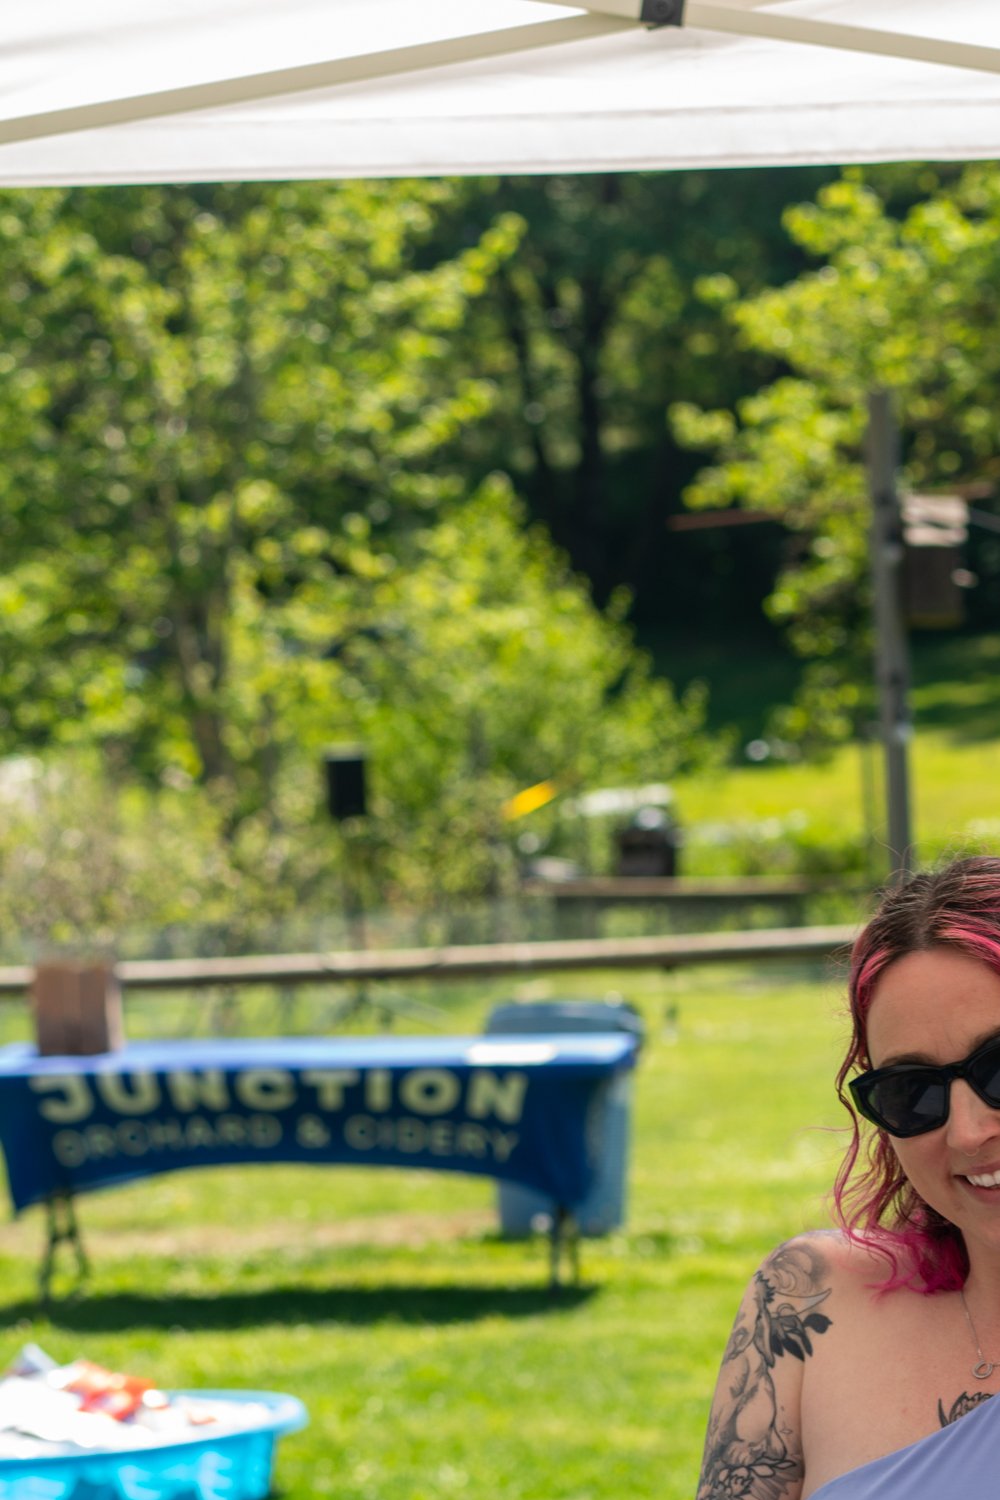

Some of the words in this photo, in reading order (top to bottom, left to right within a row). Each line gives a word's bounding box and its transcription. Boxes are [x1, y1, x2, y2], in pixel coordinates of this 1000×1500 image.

[29, 1067, 528, 1124] JUNCTION
[52, 1113, 283, 1168] ORCHARD
[296, 1113, 331, 1149] &
[343, 1113, 520, 1163] CIDERY
